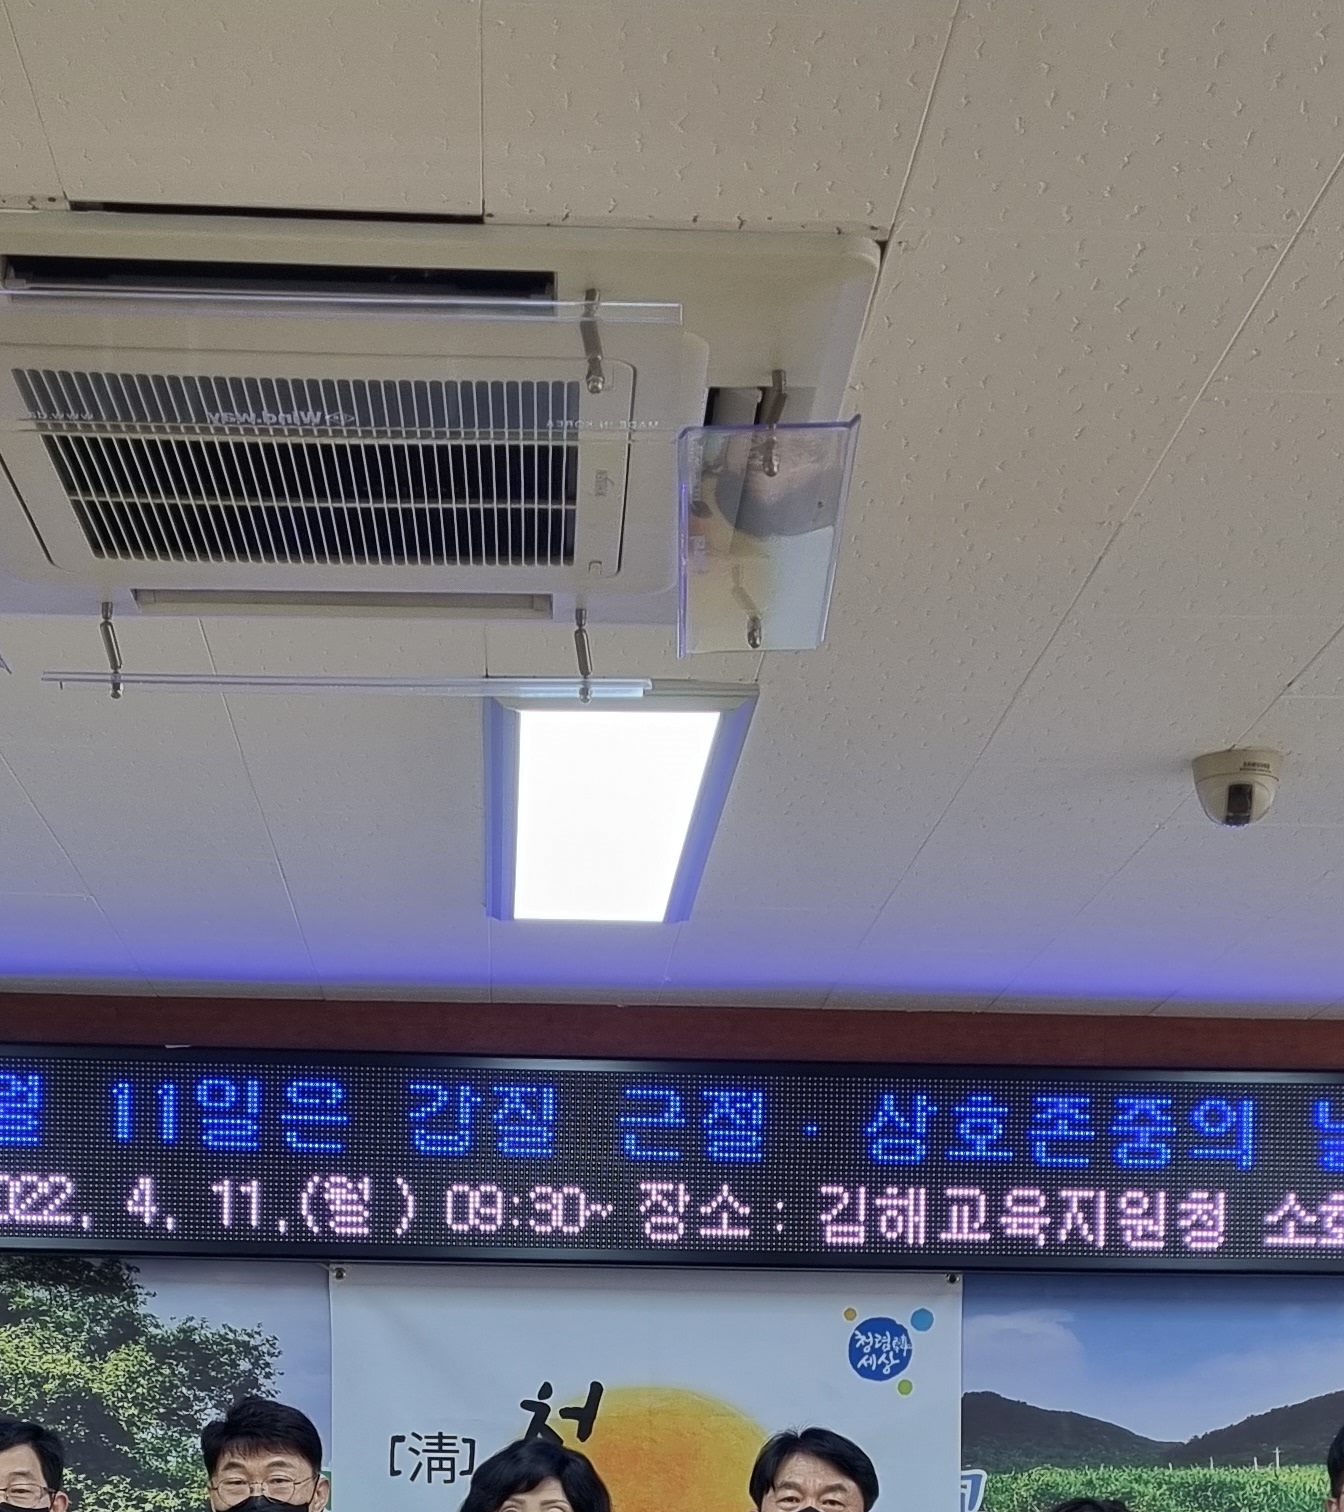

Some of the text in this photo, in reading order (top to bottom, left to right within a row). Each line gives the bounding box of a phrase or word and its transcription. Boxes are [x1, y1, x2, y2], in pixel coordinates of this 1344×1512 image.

[112, 1078, 349, 1149] 11일은
[409, 1083, 555, 1155] 갑질
[619, 1089, 763, 1159] 근절
[865, 1094, 1253, 1167] 상호존중의
[819, 1185, 1226, 1250] 김해교육지원청
[857, 1351, 900, 1375] 세상
